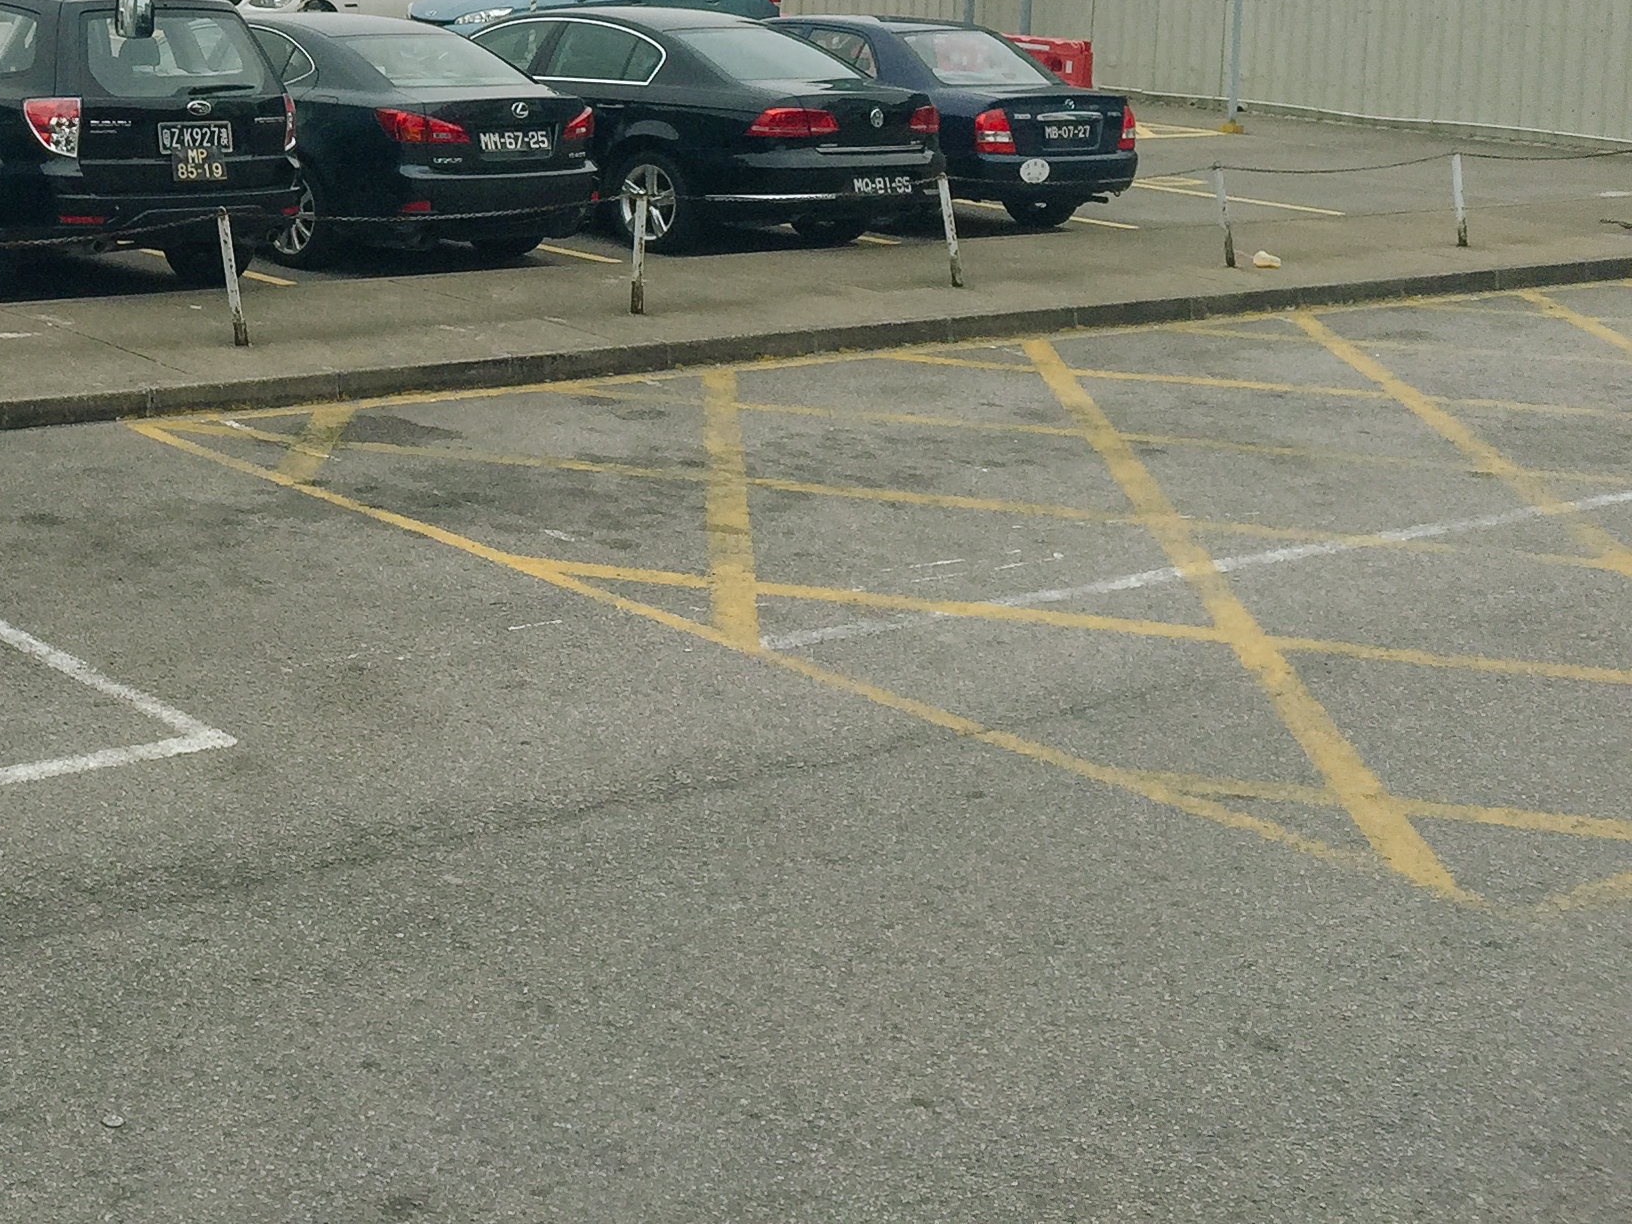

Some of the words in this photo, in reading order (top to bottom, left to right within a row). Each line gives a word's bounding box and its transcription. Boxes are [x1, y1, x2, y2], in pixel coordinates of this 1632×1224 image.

[479, 130, 549, 151] MM-67-25
[187, 148, 208, 165] MP
[177, 162, 223, 179] 85-19
